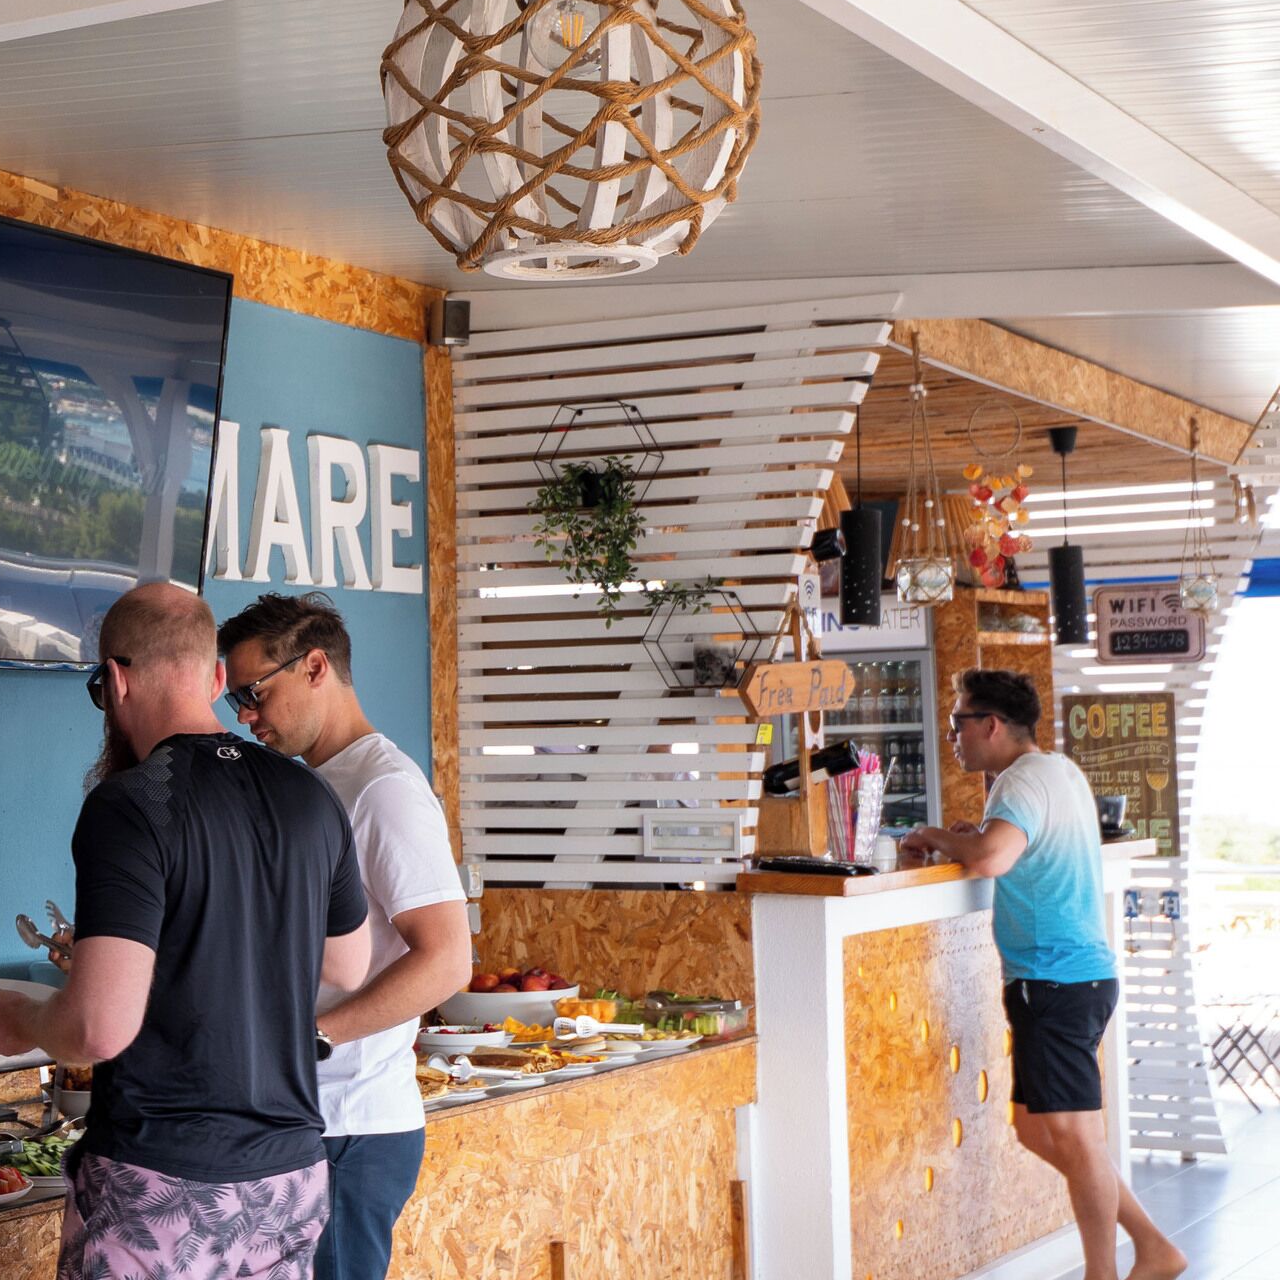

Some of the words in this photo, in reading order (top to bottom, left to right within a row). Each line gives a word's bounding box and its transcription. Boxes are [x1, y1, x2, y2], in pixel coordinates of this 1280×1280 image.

[1109, 597, 1156, 614] WIFI
[869, 607, 921, 632] ATER
[1110, 615, 1187, 628] PASSWORD
[806, 667, 848, 706] Paid
[1070, 702, 1169, 739] COFFEE
